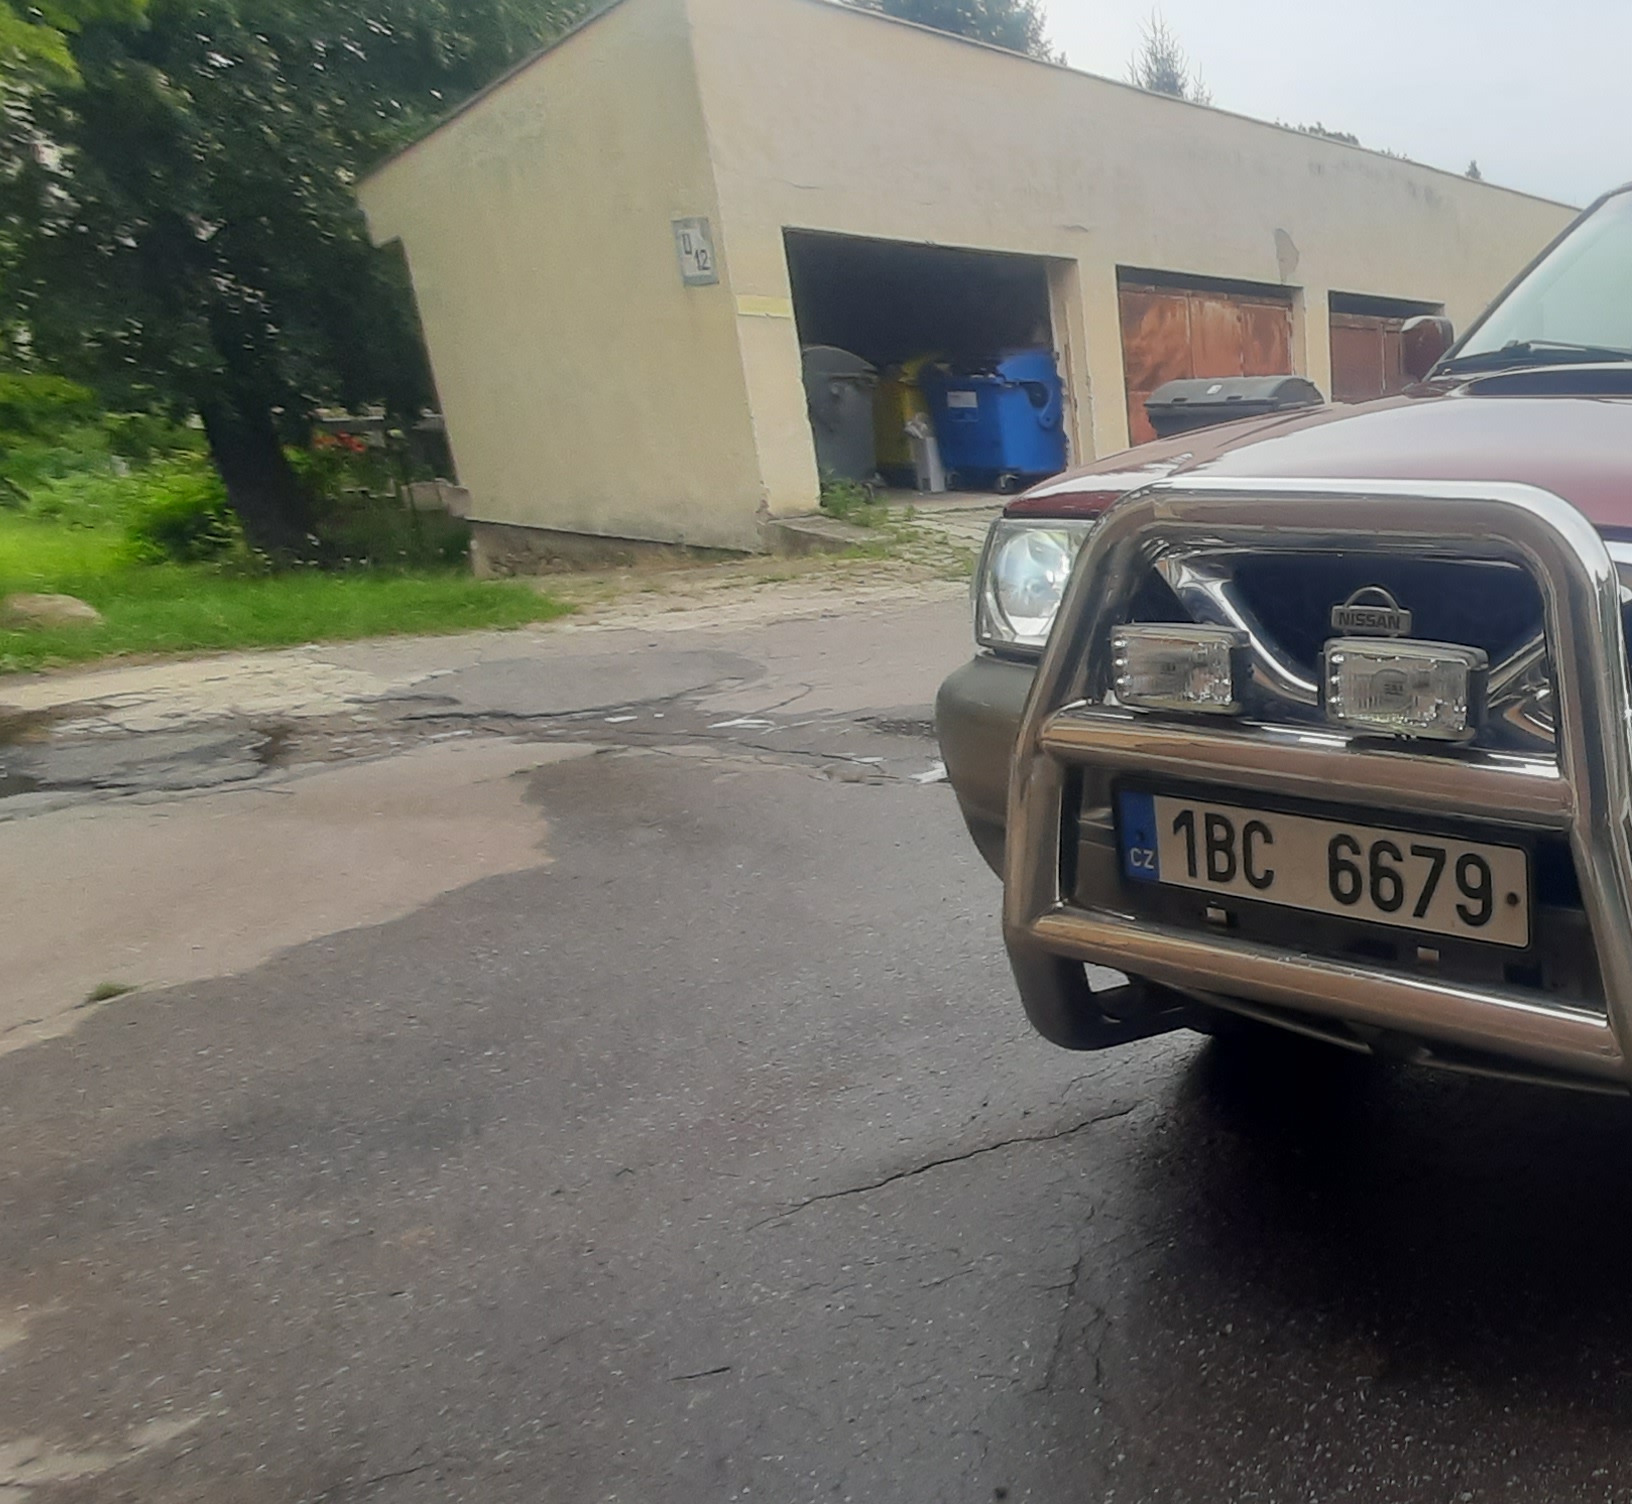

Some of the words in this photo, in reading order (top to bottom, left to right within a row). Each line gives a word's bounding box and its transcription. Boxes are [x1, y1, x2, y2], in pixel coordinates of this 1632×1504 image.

[694, 249, 711, 270] 12
[1338, 611, 1401, 630] NISSAN
[1129, 847, 1155, 870] CZ
[1172, 809, 1275, 890] 1BC
[1327, 833, 1494, 927] 6679
